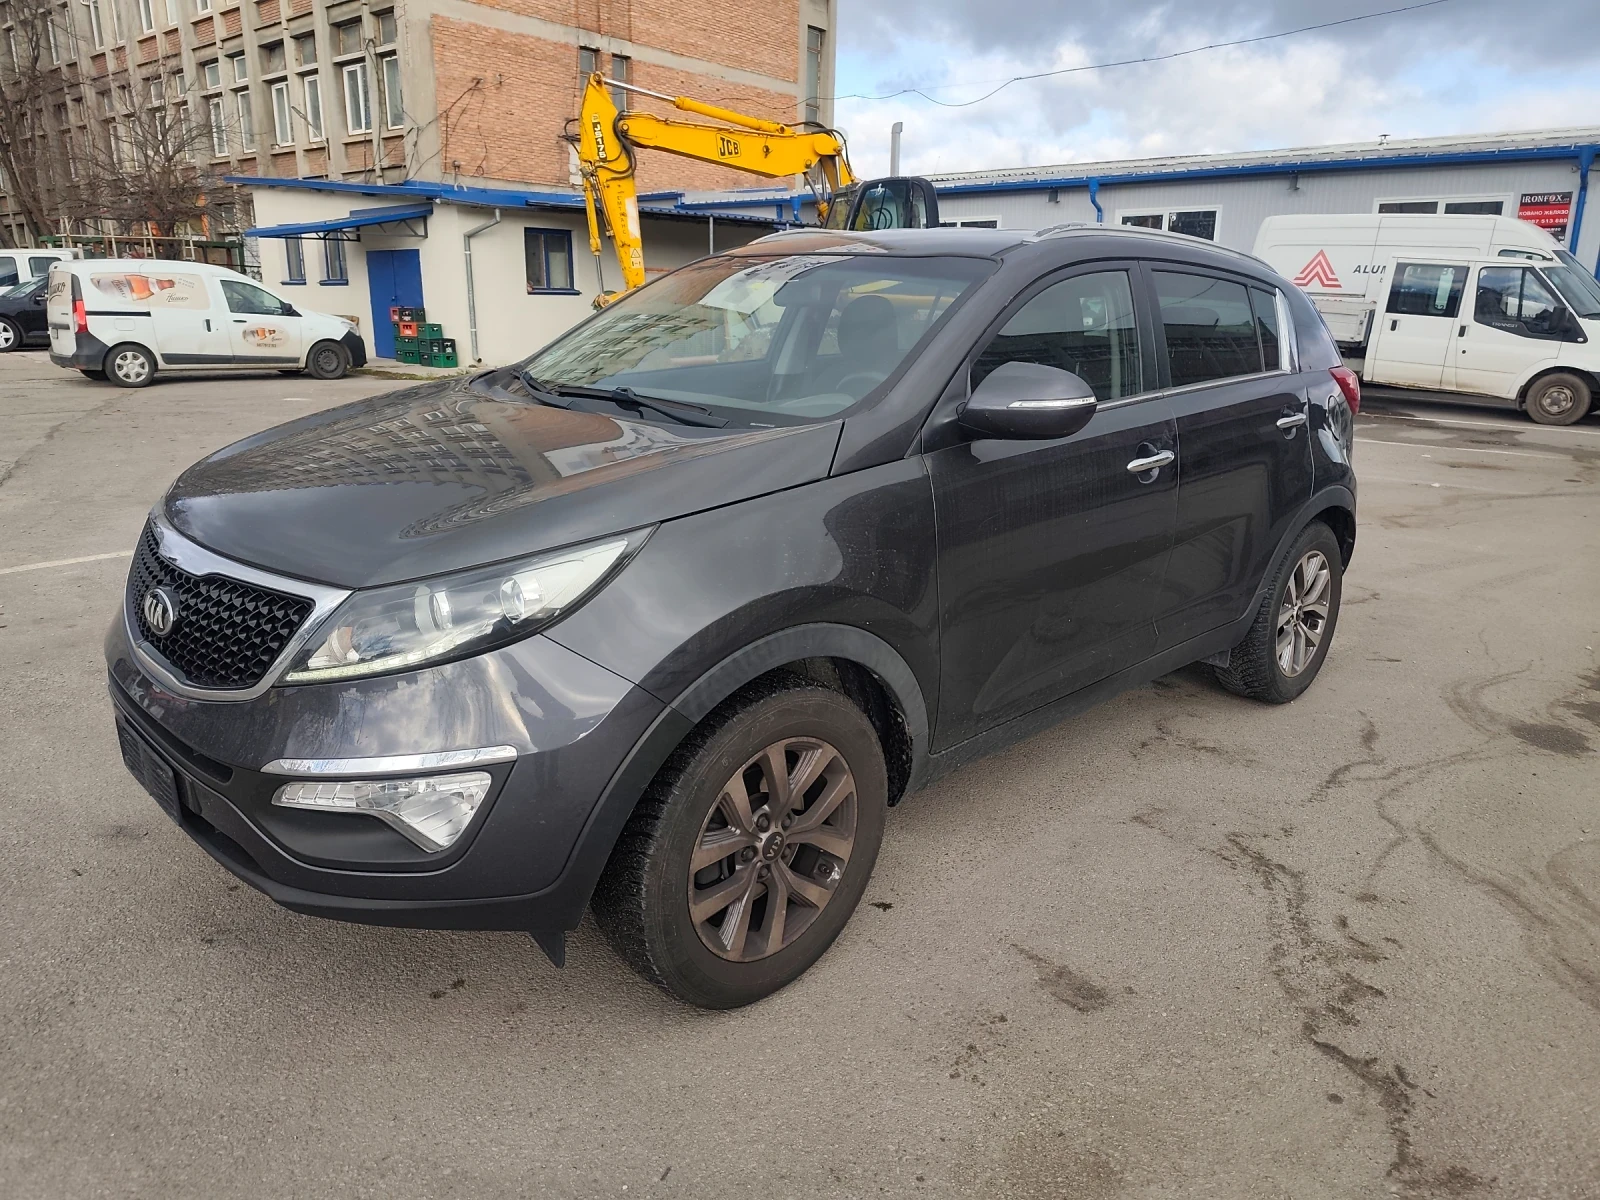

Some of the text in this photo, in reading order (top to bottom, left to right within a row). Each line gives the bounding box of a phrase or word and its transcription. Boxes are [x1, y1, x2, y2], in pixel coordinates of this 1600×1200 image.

[719, 136, 739, 157] JCB
[1522, 195, 1563, 203] IRONFOX
[766, 835, 783, 857] KIA
